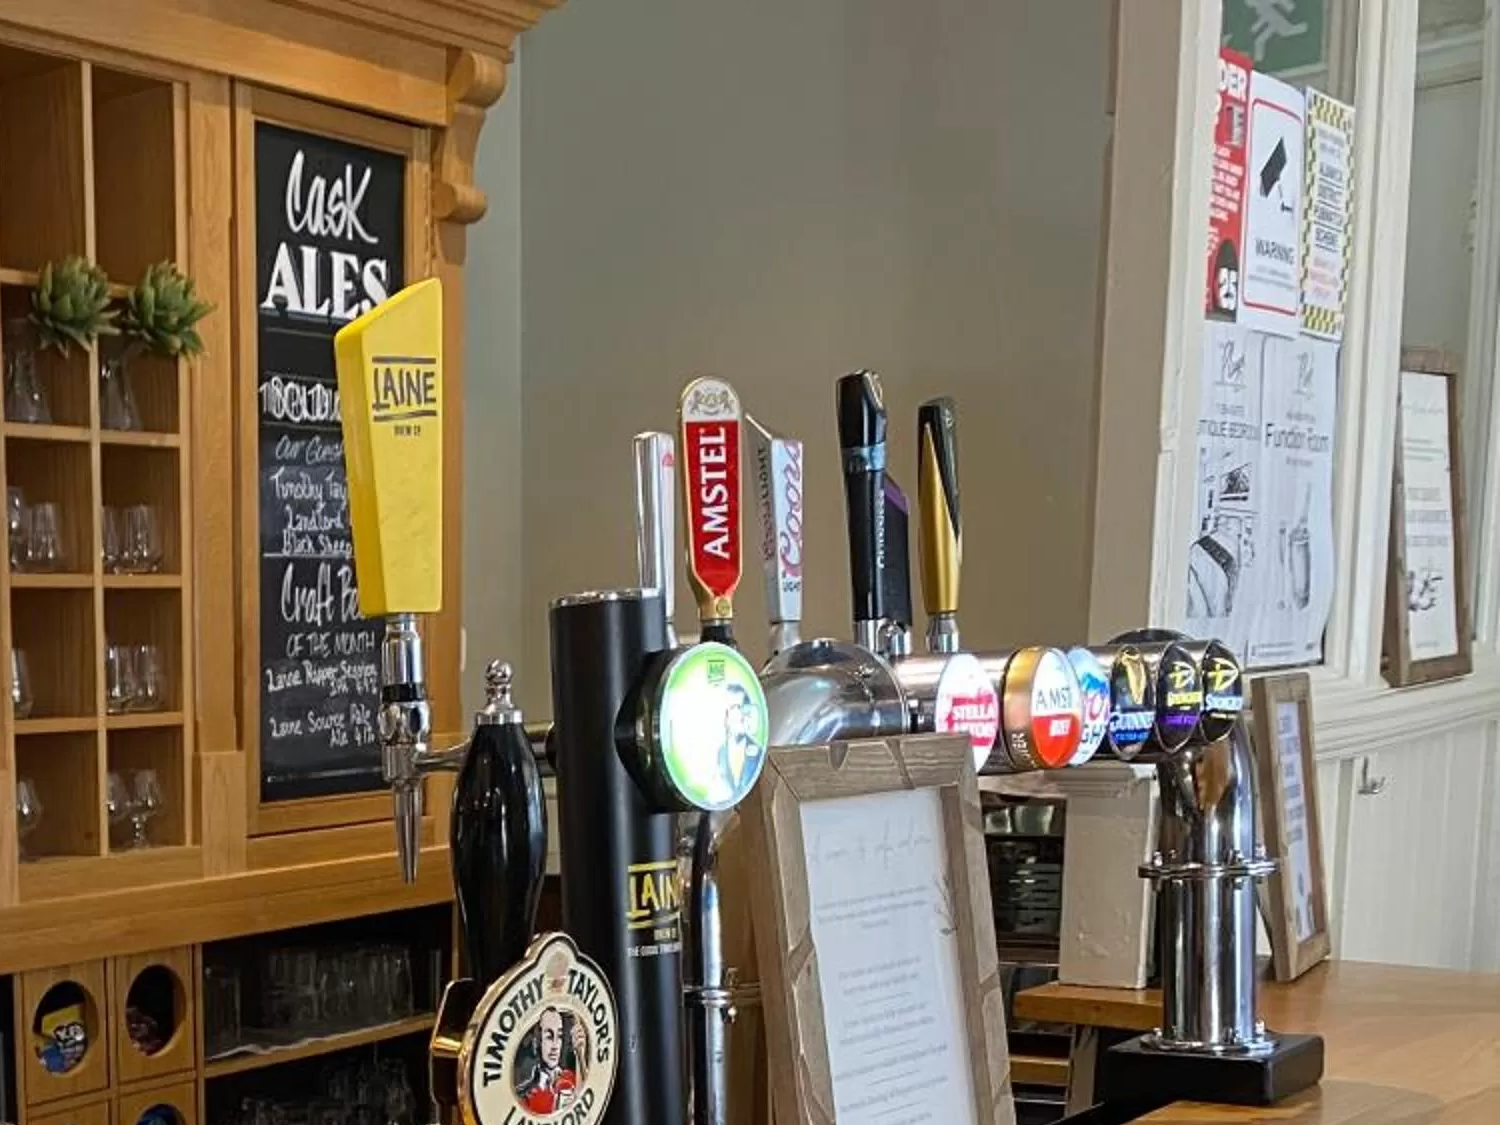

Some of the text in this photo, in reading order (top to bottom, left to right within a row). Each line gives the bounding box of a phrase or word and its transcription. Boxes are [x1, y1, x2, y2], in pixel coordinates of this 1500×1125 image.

[286, 150, 379, 243] Cask
[259, 242, 390, 321] ALES
[371, 367, 437, 412] LAINE
[703, 426, 731, 559] AMSTEL
[281, 562, 335, 627] Craft
[626, 873, 679, 919] LAIN
[483, 968, 610, 1087] TIMOTHY TAYLOR'S
